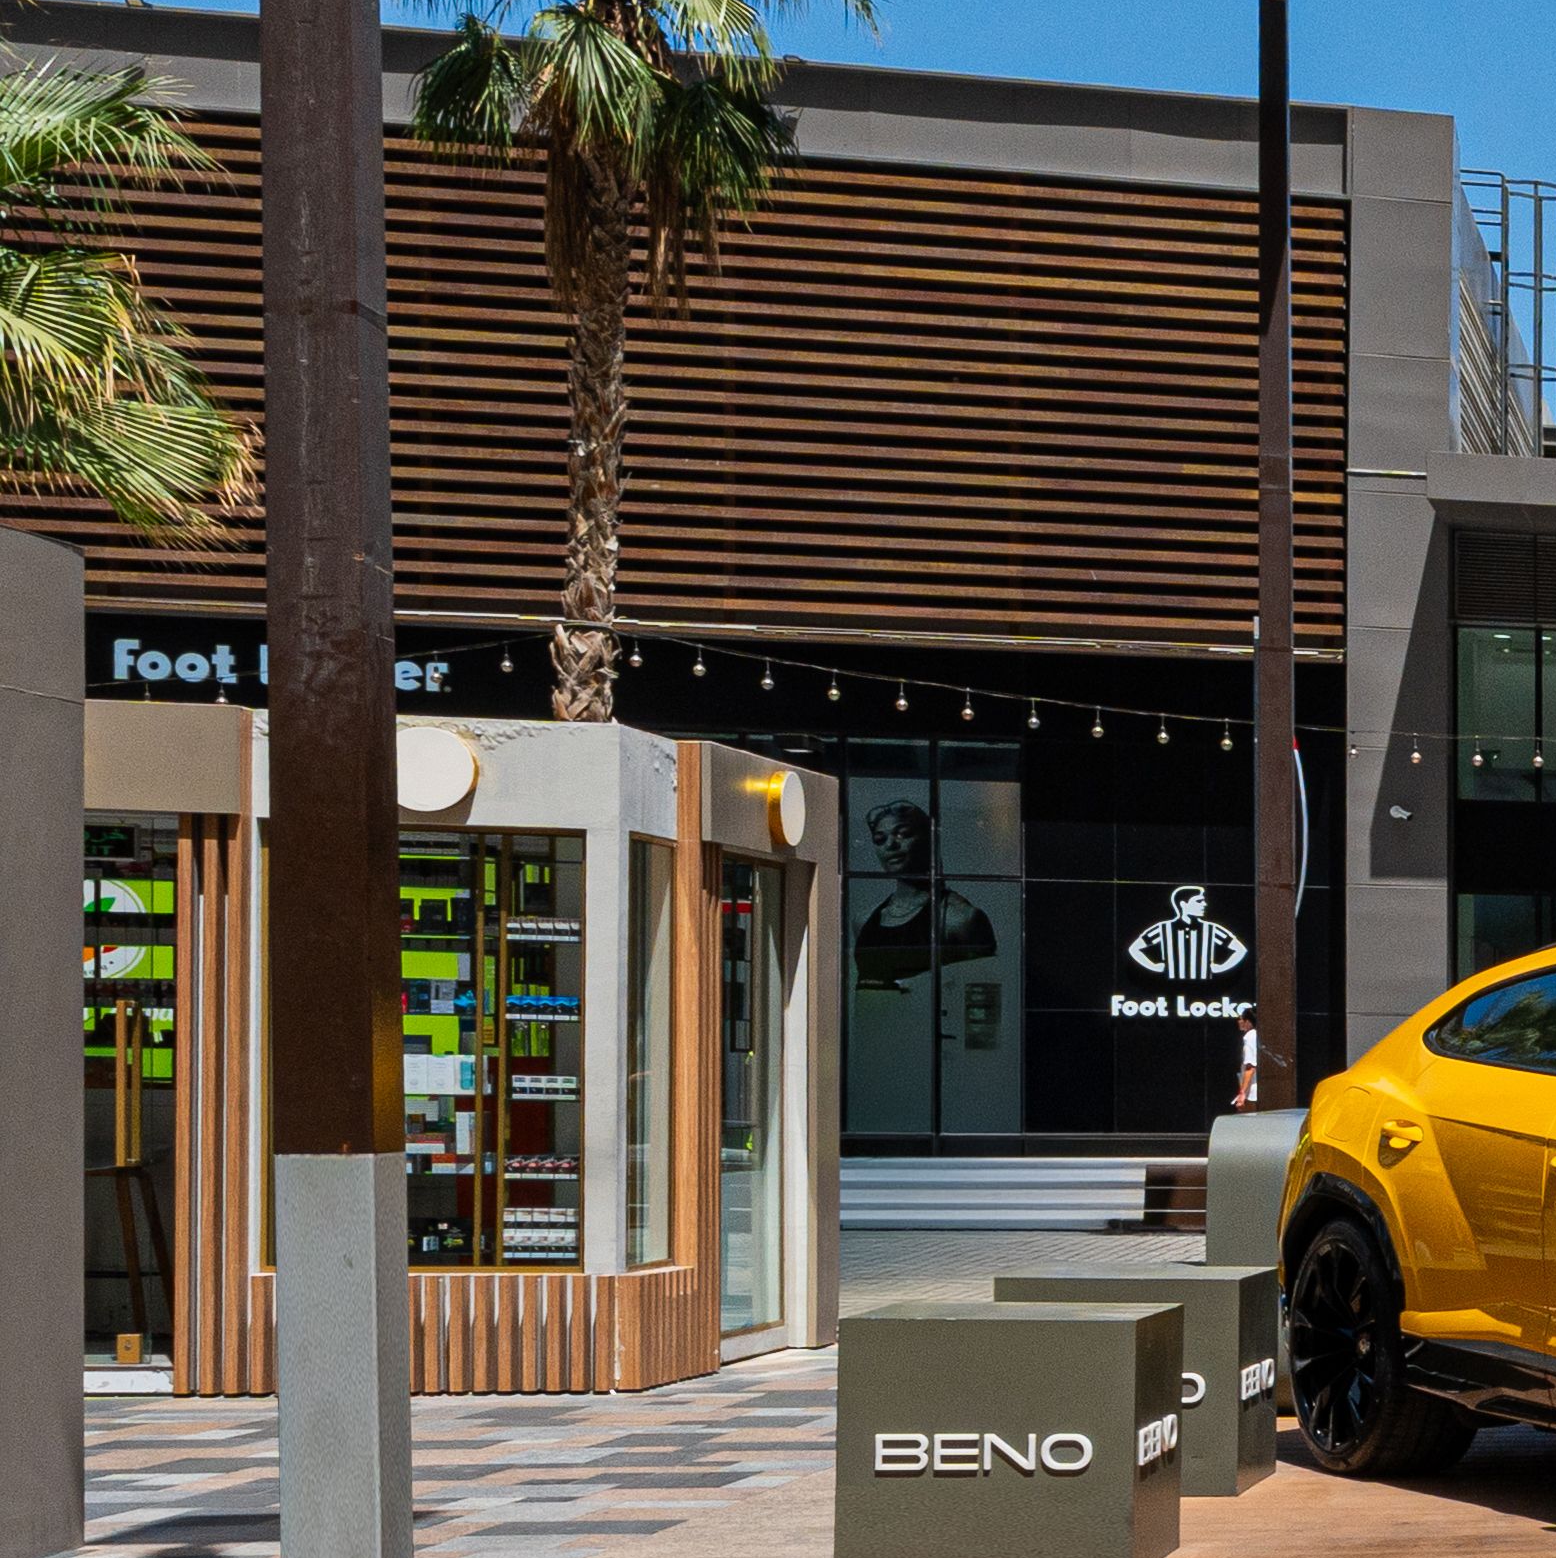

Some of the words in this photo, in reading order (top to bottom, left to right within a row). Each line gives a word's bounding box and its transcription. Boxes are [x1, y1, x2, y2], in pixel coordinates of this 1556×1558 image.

[113, 639, 239, 684] Foot
[1111, 995, 1169, 1017] Foot
[1176, 995, 1257, 1018] Lock
[874, 1433, 1094, 1471] BENO
[1138, 1413, 1178, 1466] BENO
